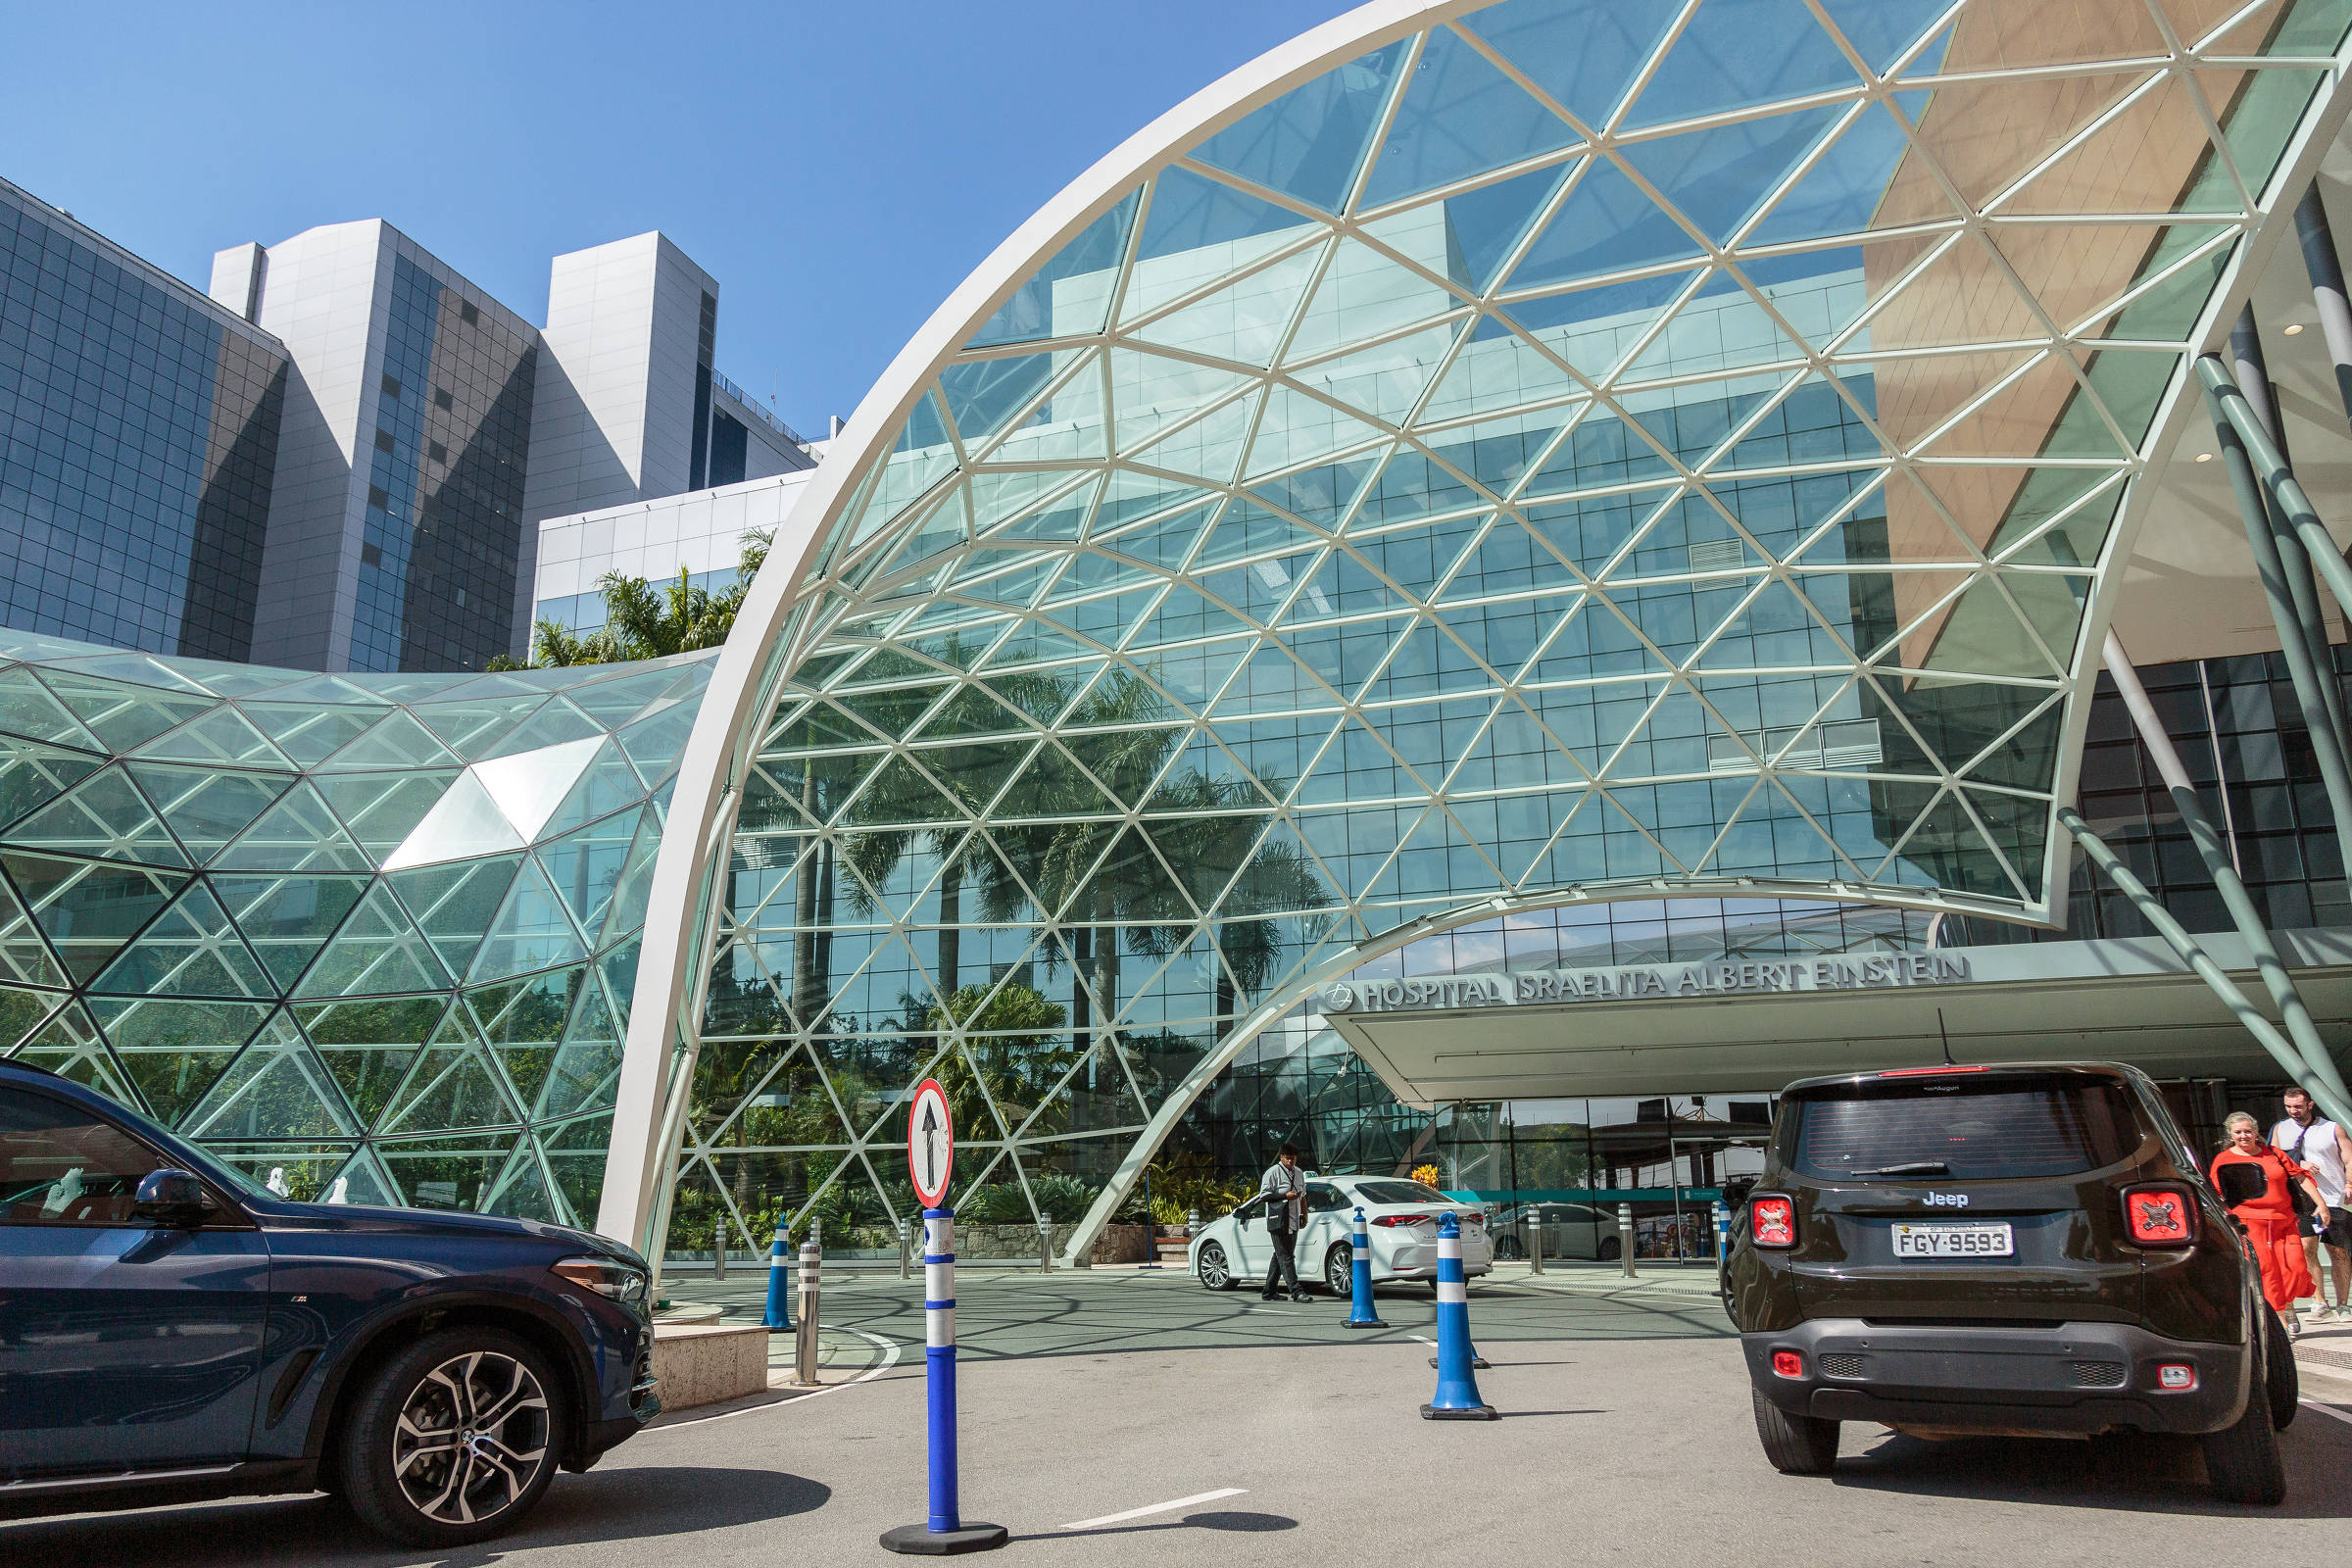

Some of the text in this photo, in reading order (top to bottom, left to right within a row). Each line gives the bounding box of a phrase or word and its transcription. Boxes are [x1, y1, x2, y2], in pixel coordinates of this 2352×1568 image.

[1363, 953, 1968, 1007] HOSPITAL ISRAELITA ALBERT EINSTEIN
[1922, 1191, 1969, 1207] Jeep
